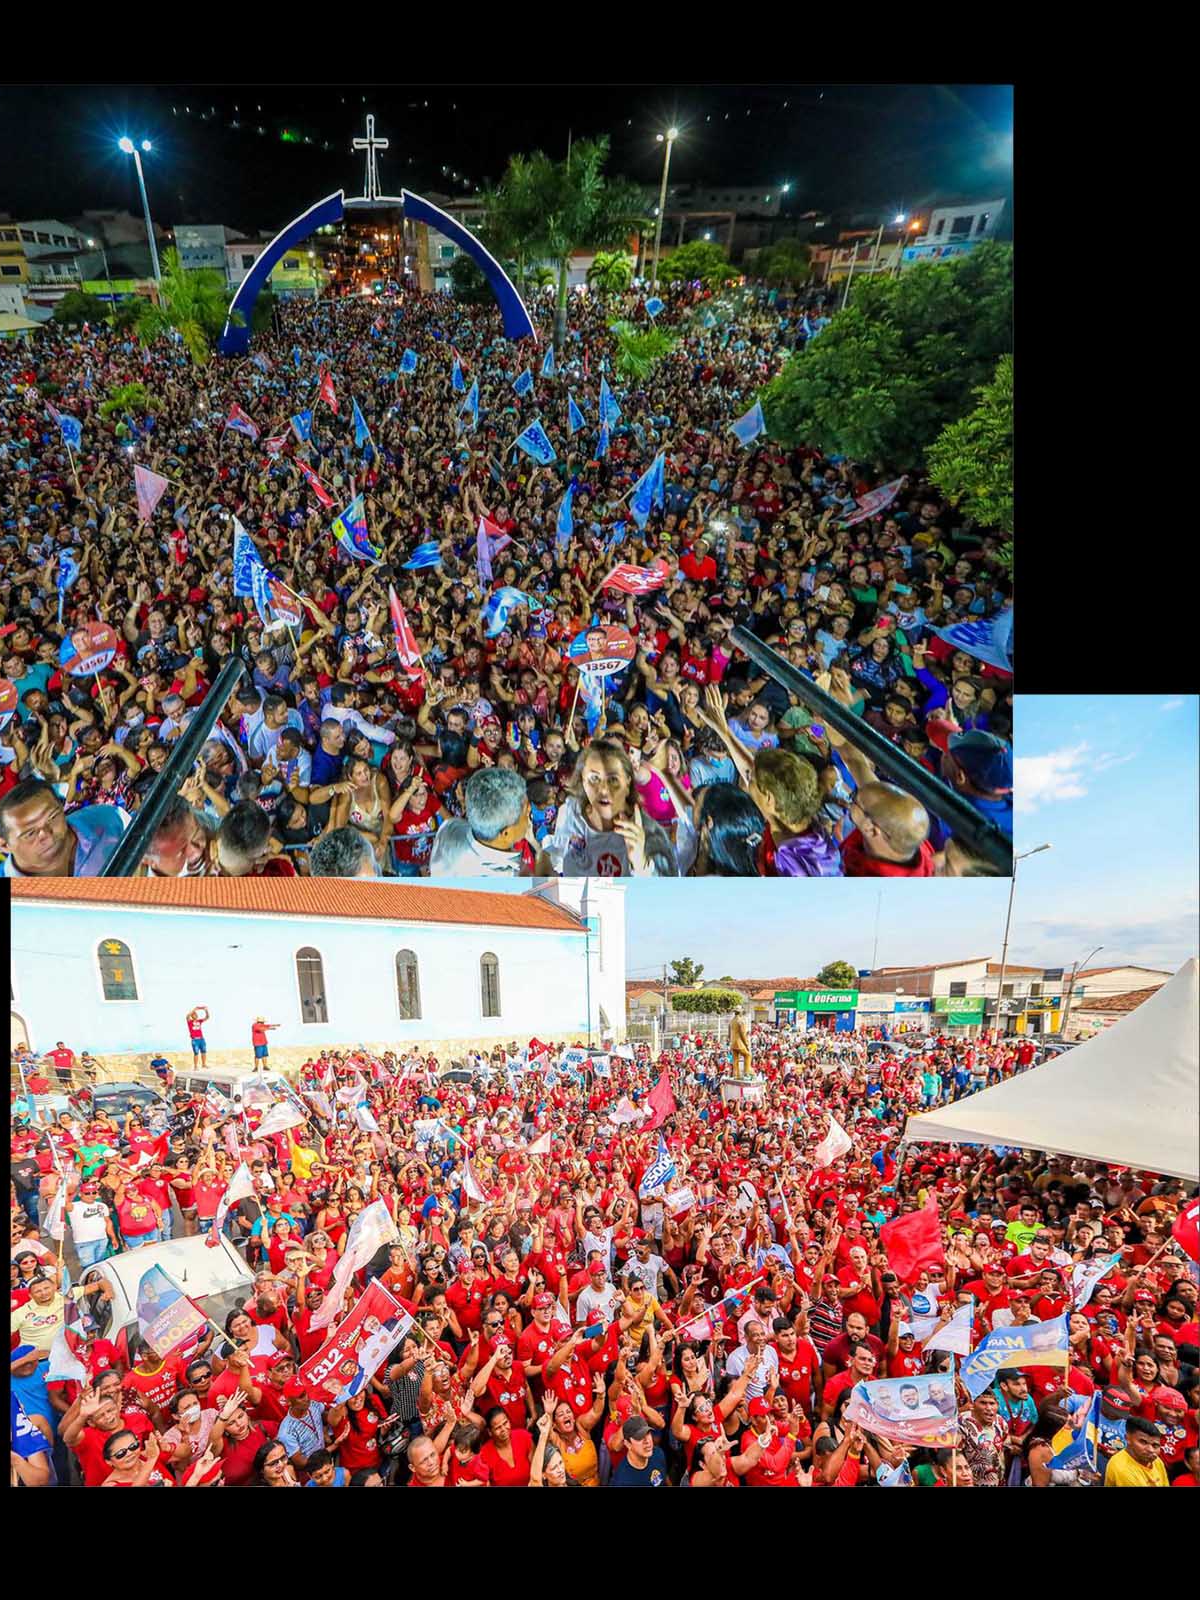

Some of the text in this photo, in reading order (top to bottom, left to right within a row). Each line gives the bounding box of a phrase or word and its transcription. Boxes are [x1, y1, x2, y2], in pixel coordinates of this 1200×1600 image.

[585, 661, 621, 671] 13567
[808, 992, 852, 1004] LéoFarma
[307, 1348, 344, 1386] 1312
